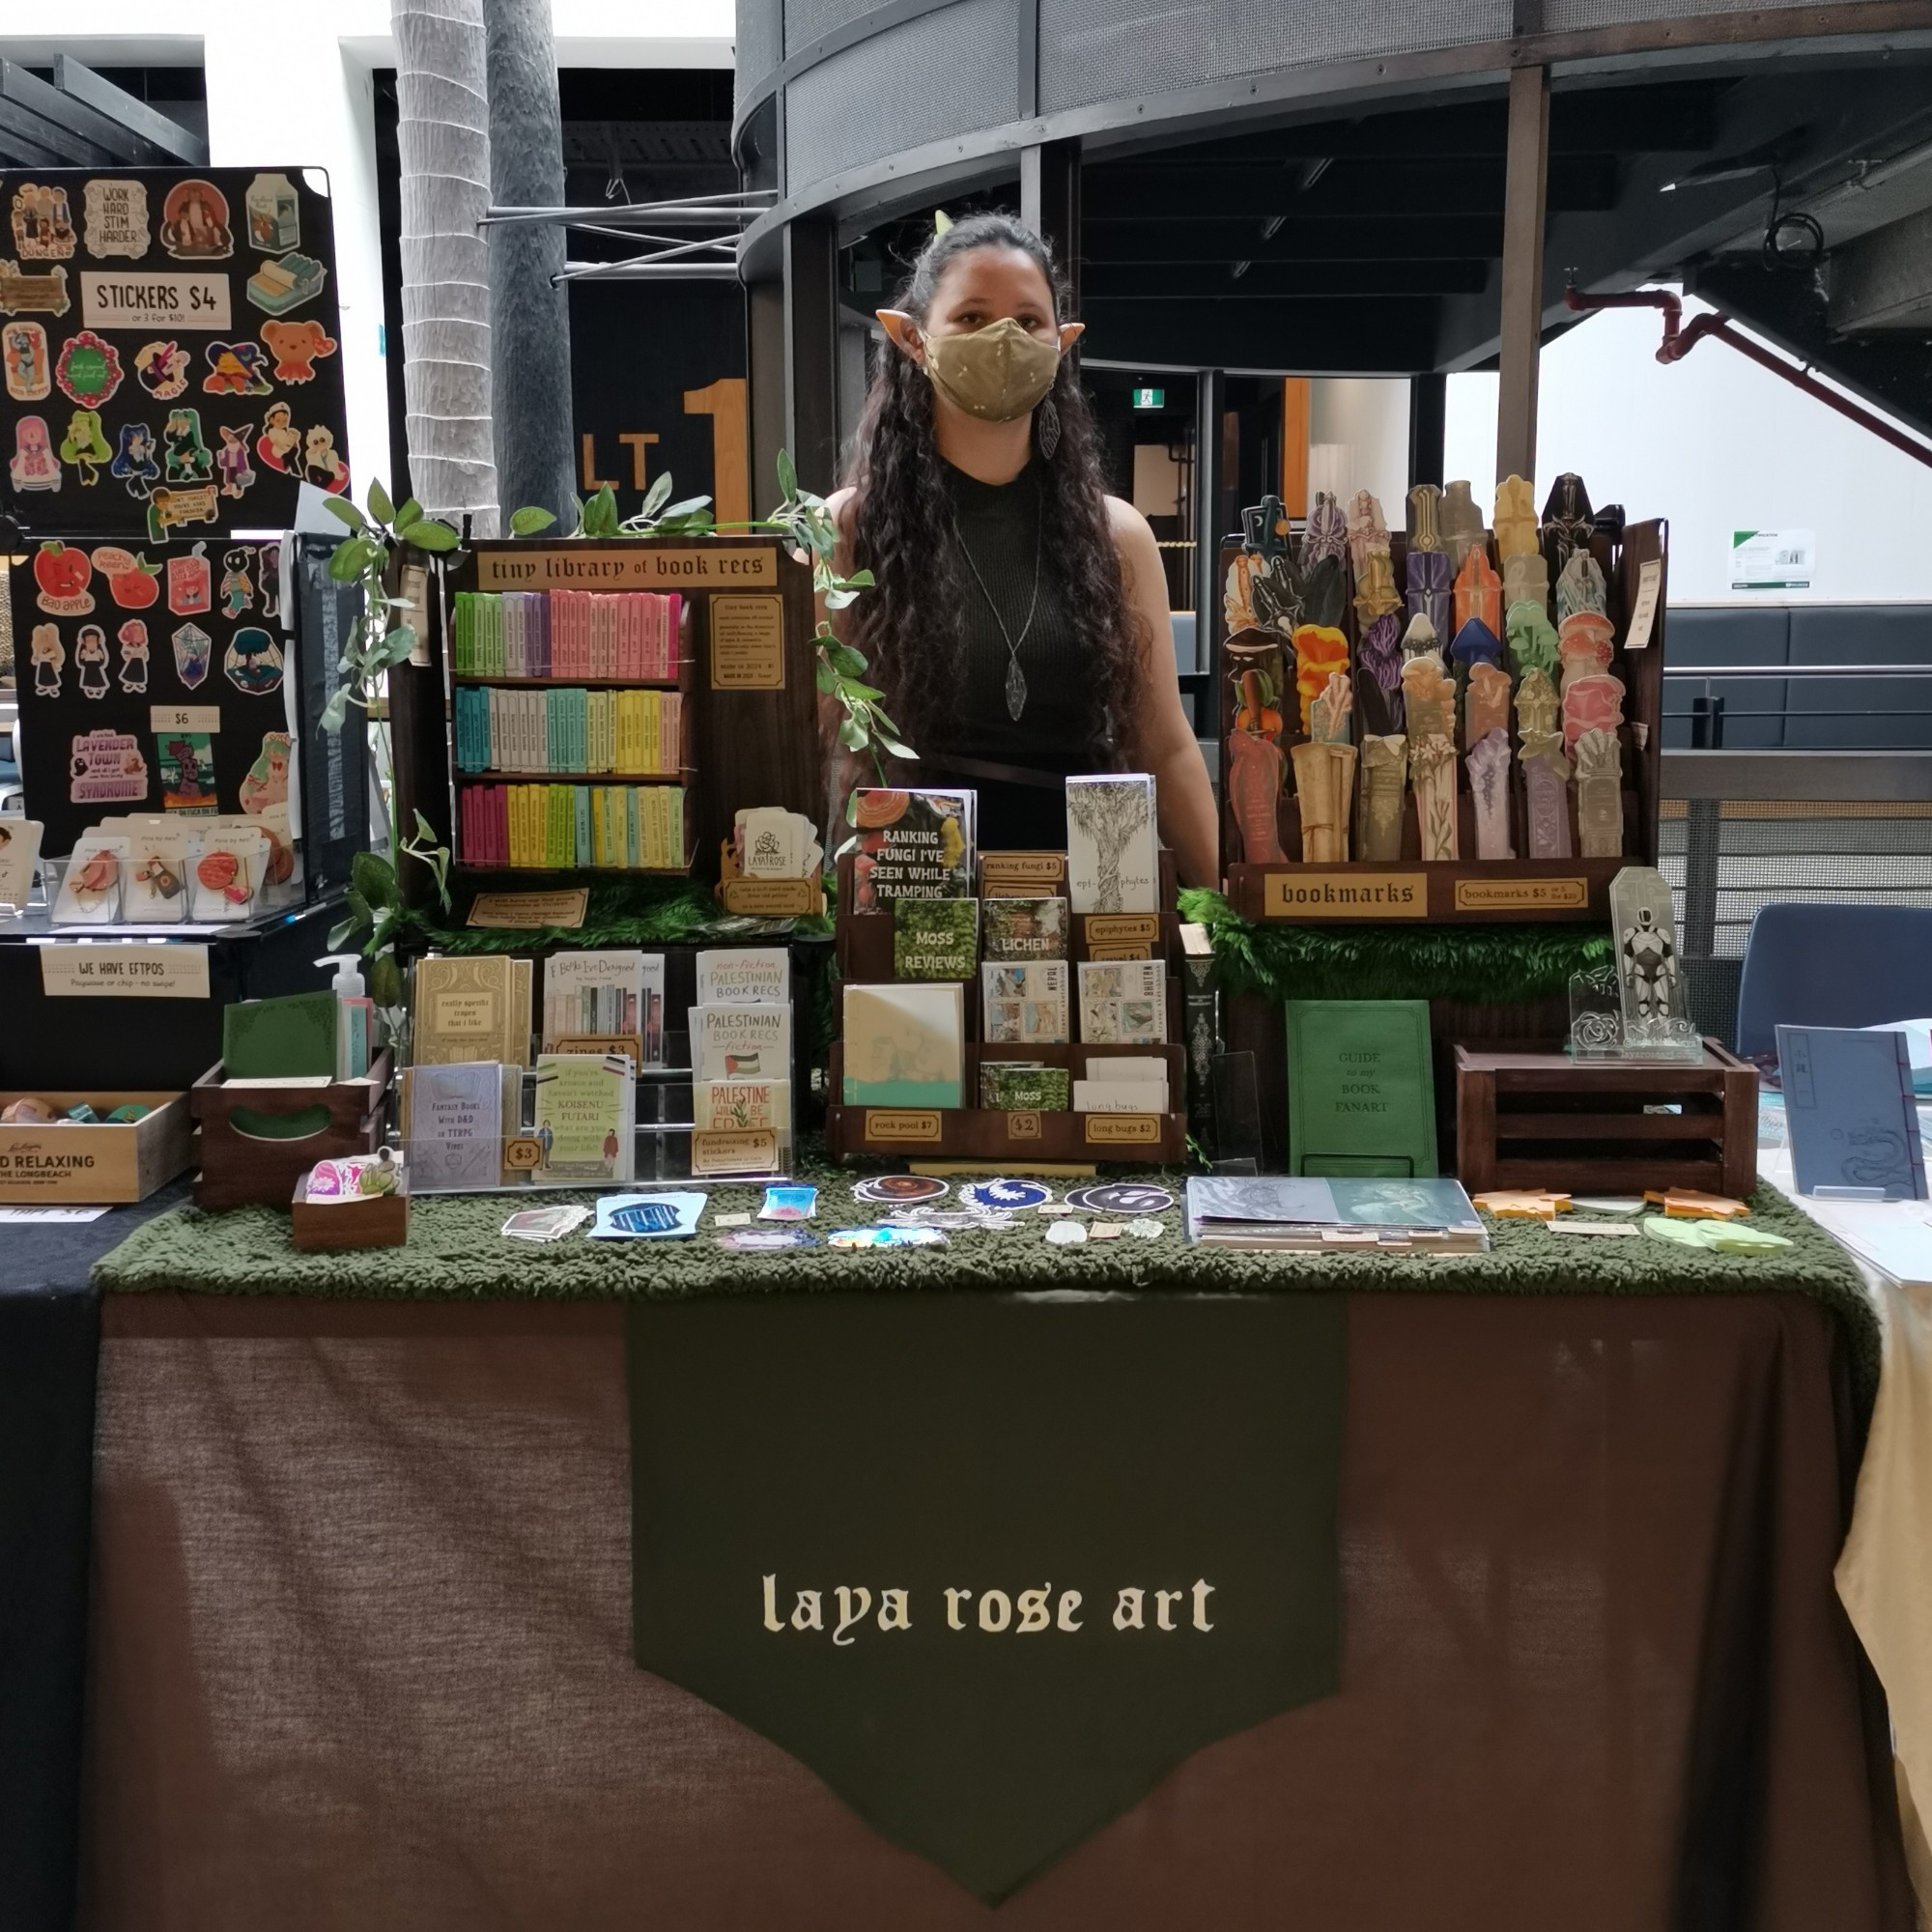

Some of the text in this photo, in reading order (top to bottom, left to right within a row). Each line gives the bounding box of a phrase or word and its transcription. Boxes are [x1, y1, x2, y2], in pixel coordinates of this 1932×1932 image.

[102, 187, 128, 201] WORK
[102, 202, 129, 215] HARD
[103, 215, 129, 229] STIM
[99, 229, 136, 243] HARDER
[97, 285, 216, 310] STICKERS $4
[169, 314, 185, 323] $10!
[155, 380, 187, 398] MAGIC
[582, 379, 750, 527] LT 1
[492, 554, 763, 582] tiny library of book recs
[175, 713, 189, 724] $6
[76, 739, 134, 753] LAVENDER
[88, 753, 121, 765] TOWN
[79, 781, 138, 800] SYNDROME
[883, 830, 938, 844] RANKING
[770, 856, 786, 866] ROSE
[877, 849, 944, 862] FUNGI I'VE
[986, 863, 1019, 871] ranking
[1022, 862, 1043, 871] fungi
[869, 867, 951, 880] SEEN WHILE
[1076, 876, 1149, 890] epi- phytes
[877, 885, 943, 897] TRAMPING
[1282, 883, 1413, 903] bookmarks
[1464, 889, 1528, 898] bookmarks
[1095, 923, 1151, 935] epiphytes $5
[916, 931, 953, 945] MOSS
[1002, 938, 1049, 952] LICHEN
[79, 962, 164, 976] WE HAVE EFTPOS
[560, 961, 582, 975] Books
[599, 959, 635, 977] Designed
[717, 959, 776, 970] non-fiction
[905, 956, 966, 969] REVIEWS
[117, 979, 133, 988] chip
[710, 970, 782, 986] PALESTINIAN
[1047, 967, 1058, 990] NEPAL
[1143, 966, 1153, 996] BHUTAN
[717, 985, 781, 998] BOOK RECS
[707, 1013, 781, 1028] PALESTINIAN
[714, 1029, 779, 1041] BOOK RECS
[609, 1045, 626, 1055] $3
[724, 1041, 762, 1050] fiction
[1339, 1053, 1381, 1063] GUIDE
[574, 1068, 598, 1077] you're
[712, 1086, 770, 1104] PALESTINE
[1342, 1084, 1380, 1094] BOOK
[1014, 1092, 1041, 1101] MOSS
[558, 1100, 604, 1109] KOISENU
[751, 1105, 763, 1115] BE
[1087, 1100, 1138, 1111] long bugs
[1335, 1101, 1388, 1112] FANART
[458, 1115, 473, 1123] D&D
[898, 1122, 919, 1130] pool
[921, 1121, 931, 1129] $7
[1014, 1118, 1034, 1131] $2
[448, 1128, 472, 1137] TTRPG
[1094, 1123, 1151, 1134] long bugs $2
[753, 1139, 767, 1148] $5
[516, 1148, 532, 1159] $3
[14, 1155, 95, 1168] RELAXING
[762, 1573, 1216, 1646] laya rose art
